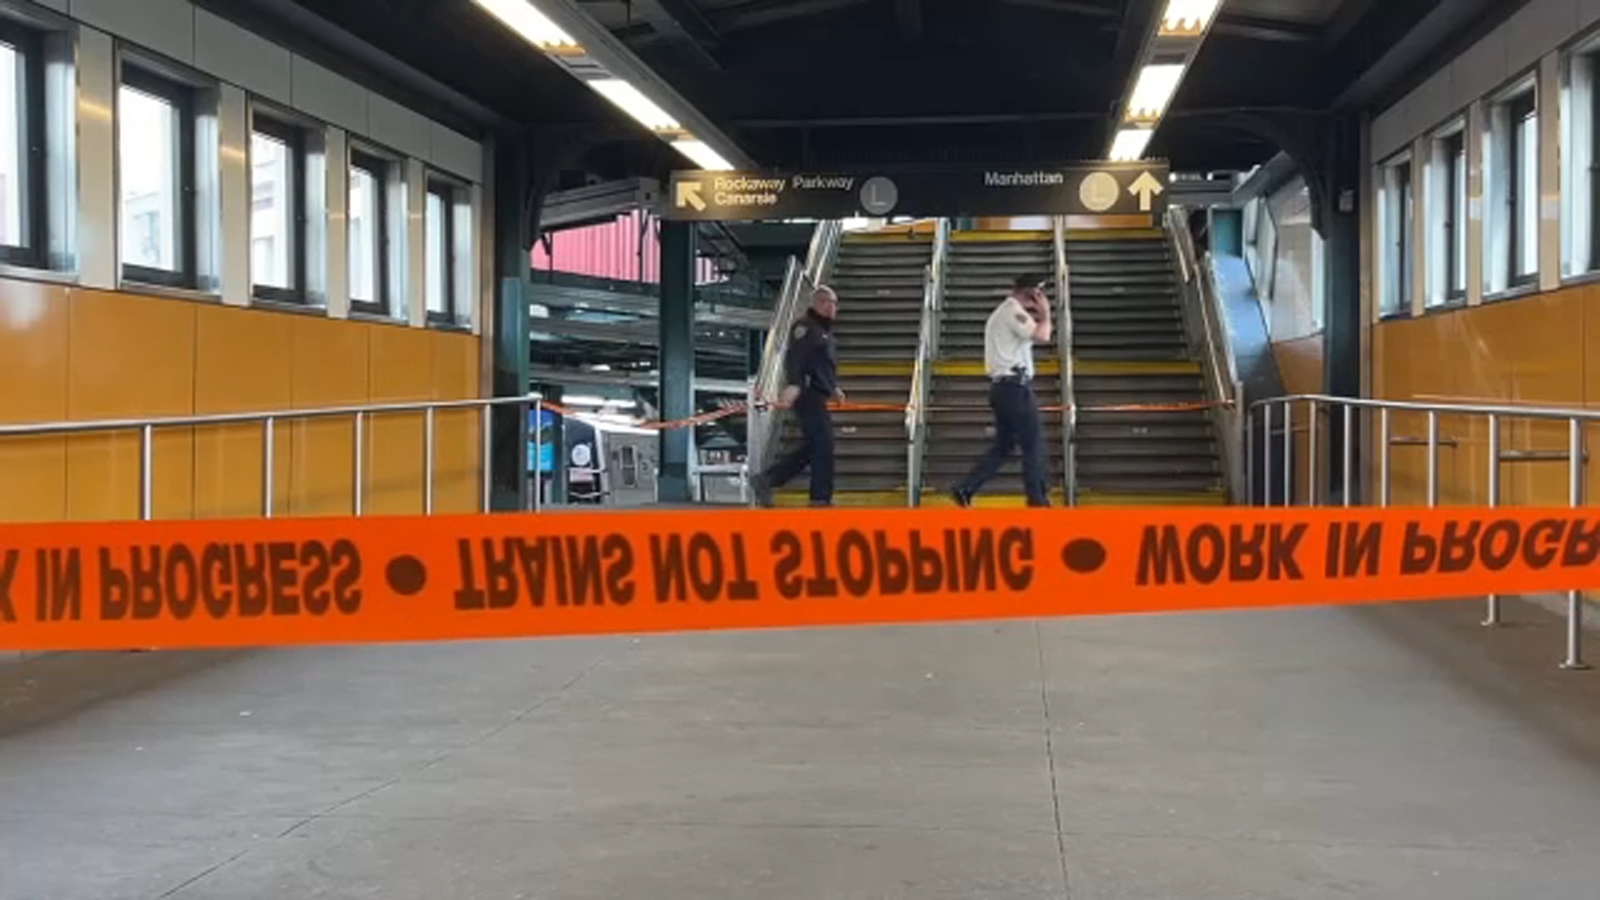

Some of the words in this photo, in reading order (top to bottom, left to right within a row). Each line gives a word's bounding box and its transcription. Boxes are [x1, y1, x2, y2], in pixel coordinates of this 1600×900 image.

[714, 176, 786, 192] Rockaway
[793, 176, 854, 191] Parkway
[985, 171, 1063, 186] Manhattan
[715, 191, 777, 206] Canarsie
